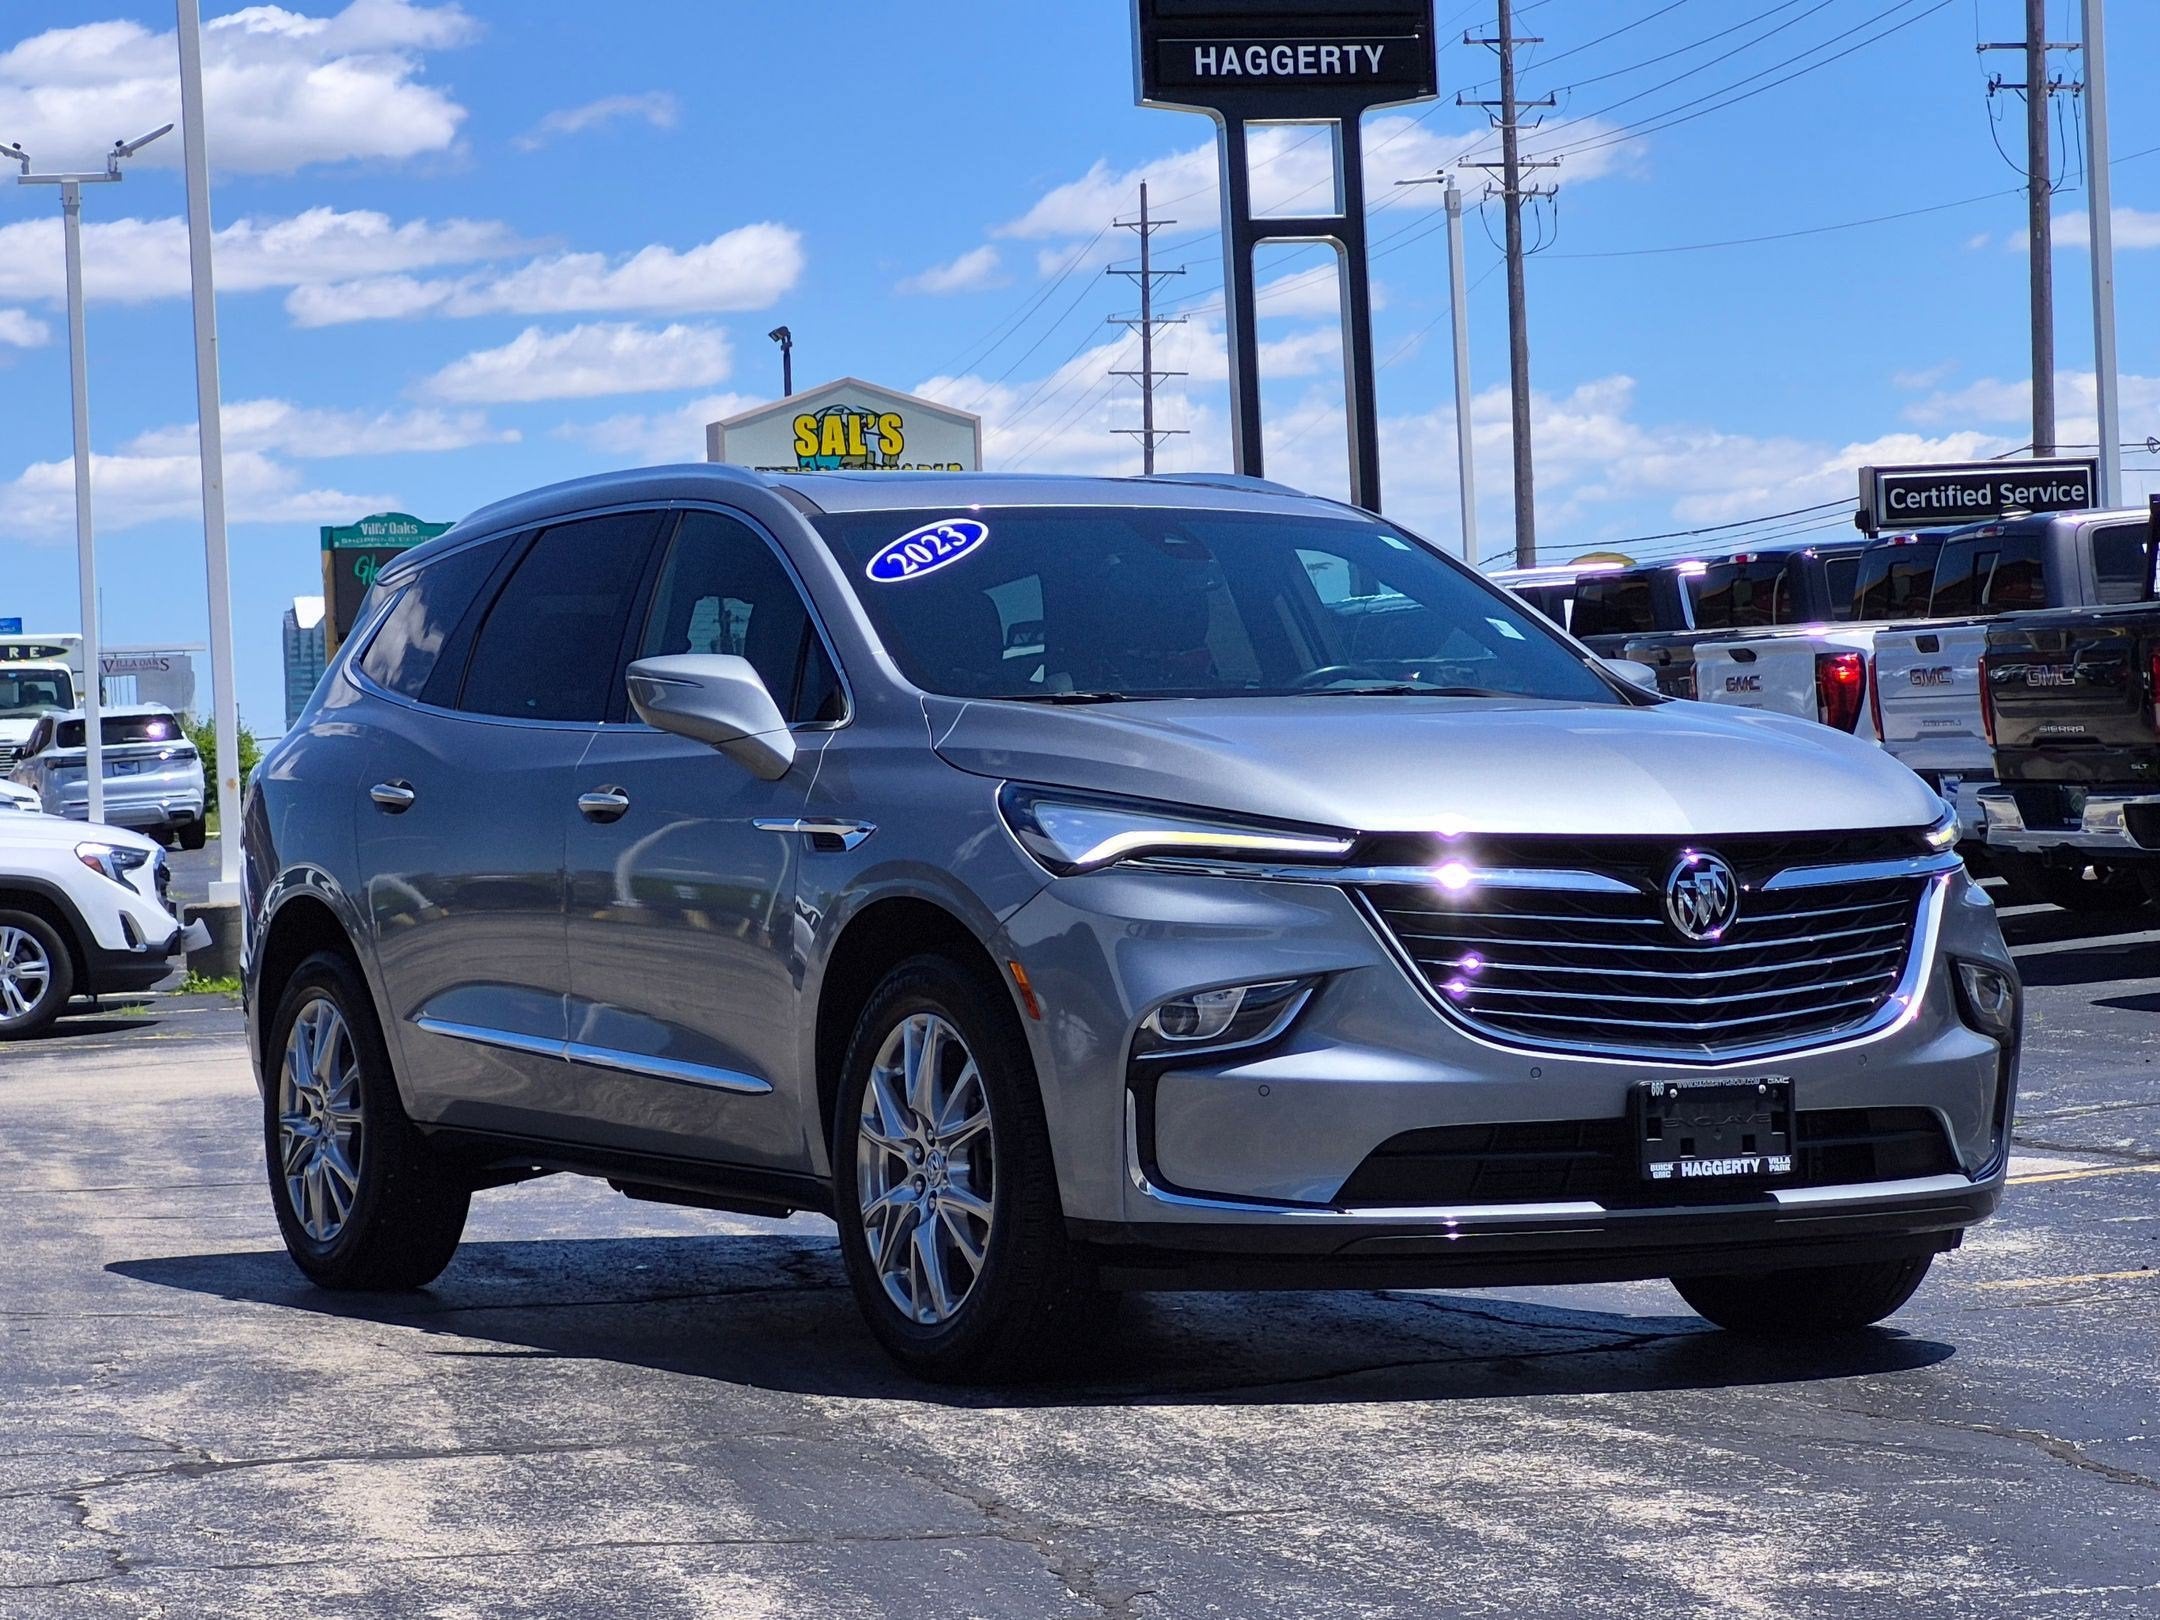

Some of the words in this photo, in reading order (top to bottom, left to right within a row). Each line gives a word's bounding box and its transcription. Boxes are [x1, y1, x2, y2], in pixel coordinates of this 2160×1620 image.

[1194, 44, 1384, 76] HAGGERTY
[793, 413, 904, 456] SAL'S
[1889, 483, 1992, 509] Certified
[2000, 480, 2085, 504] Service
[389, 522, 418, 535] Oaks
[886, 526, 967, 575] 2023
[102, 658, 136, 673] VILLA
[139, 657, 170, 672] OAKS
[1725, 675, 1762, 692] GMC
[1909, 666, 1953, 686] GMC
[2026, 664, 2076, 687] GMC
[1650, 1162, 1674, 1172] BUICK
[1681, 1158, 1760, 1177] HAGGERTY
[1768, 1156, 1791, 1165] VILLA
[1769, 1163, 1791, 1172] PARK
[1653, 1170, 1671, 1179] GMC
